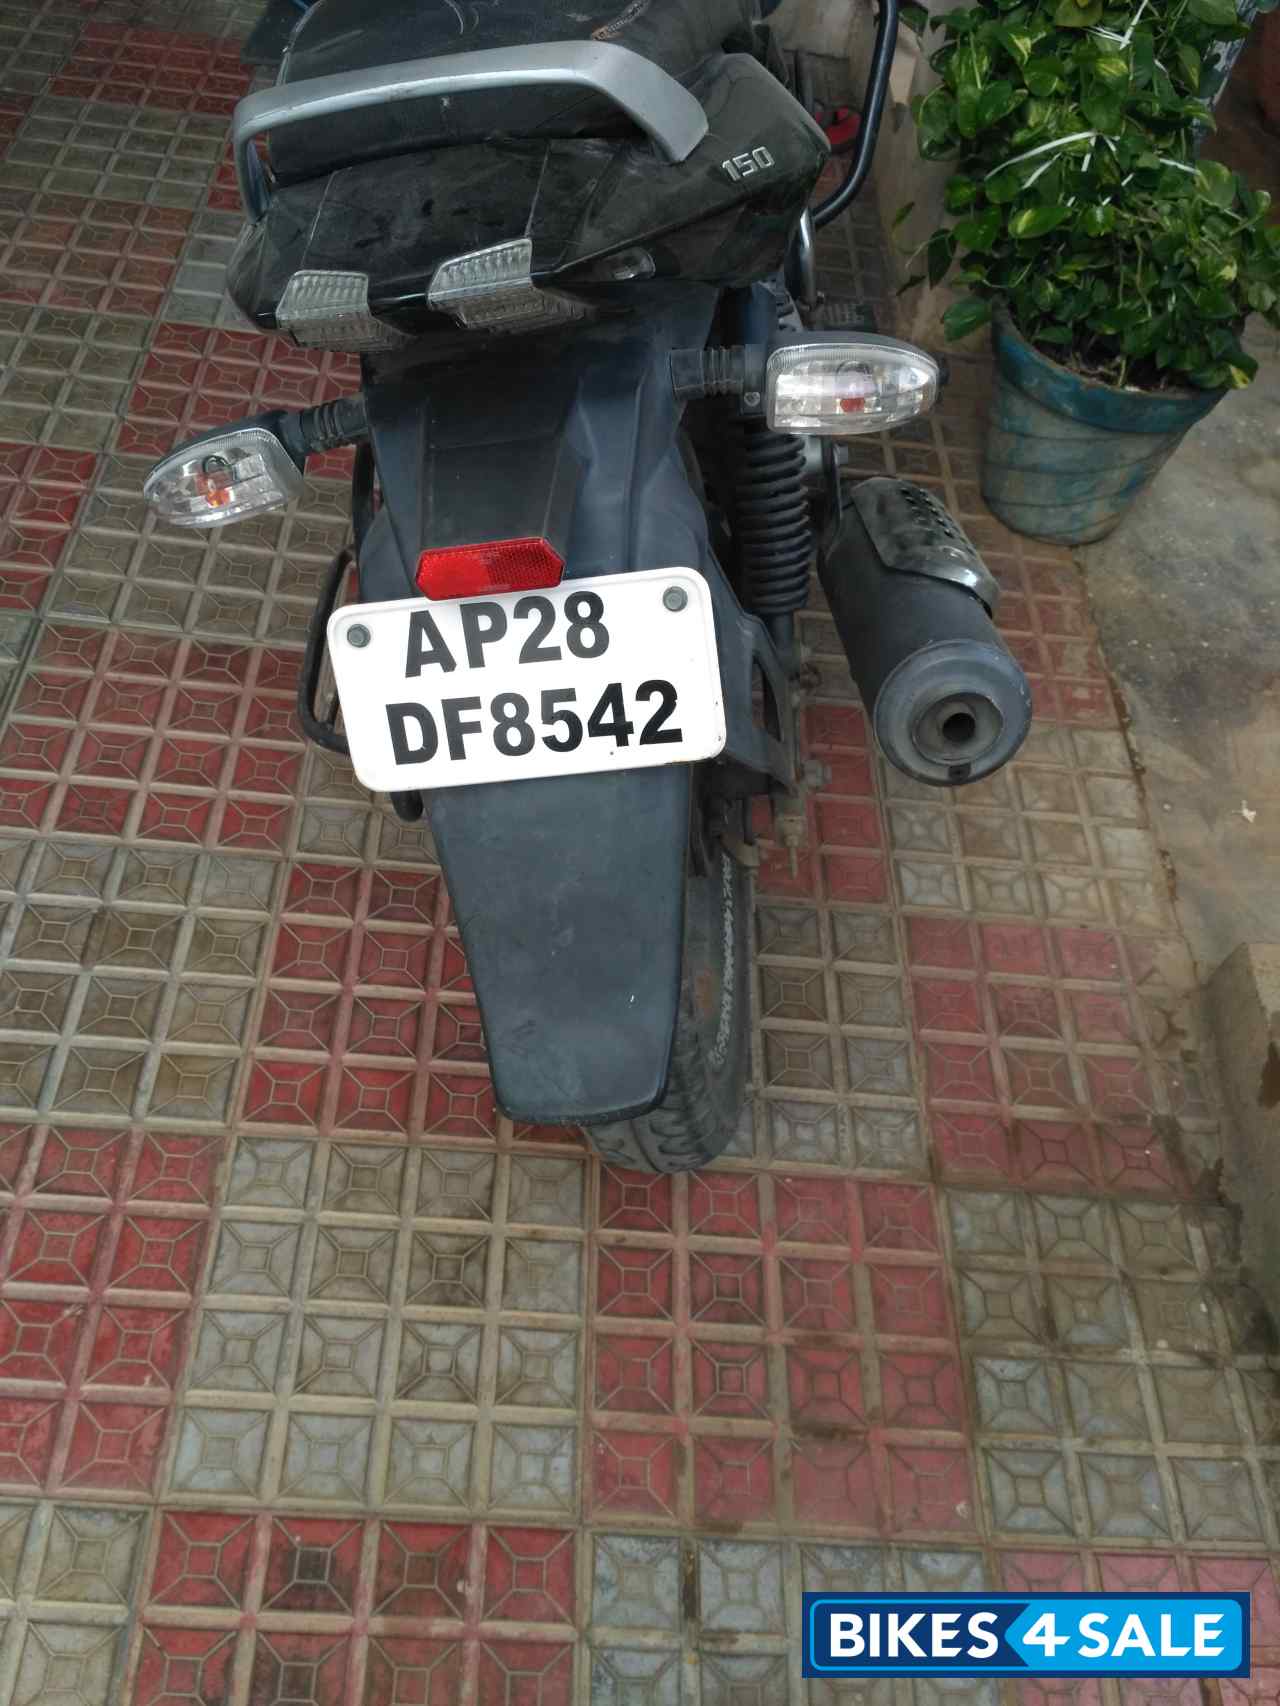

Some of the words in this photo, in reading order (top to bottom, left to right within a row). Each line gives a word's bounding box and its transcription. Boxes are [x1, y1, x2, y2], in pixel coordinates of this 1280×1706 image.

[722, 146, 775, 181] 150
[405, 591, 610, 678] AP28
[385, 679, 683, 766] DF8542
